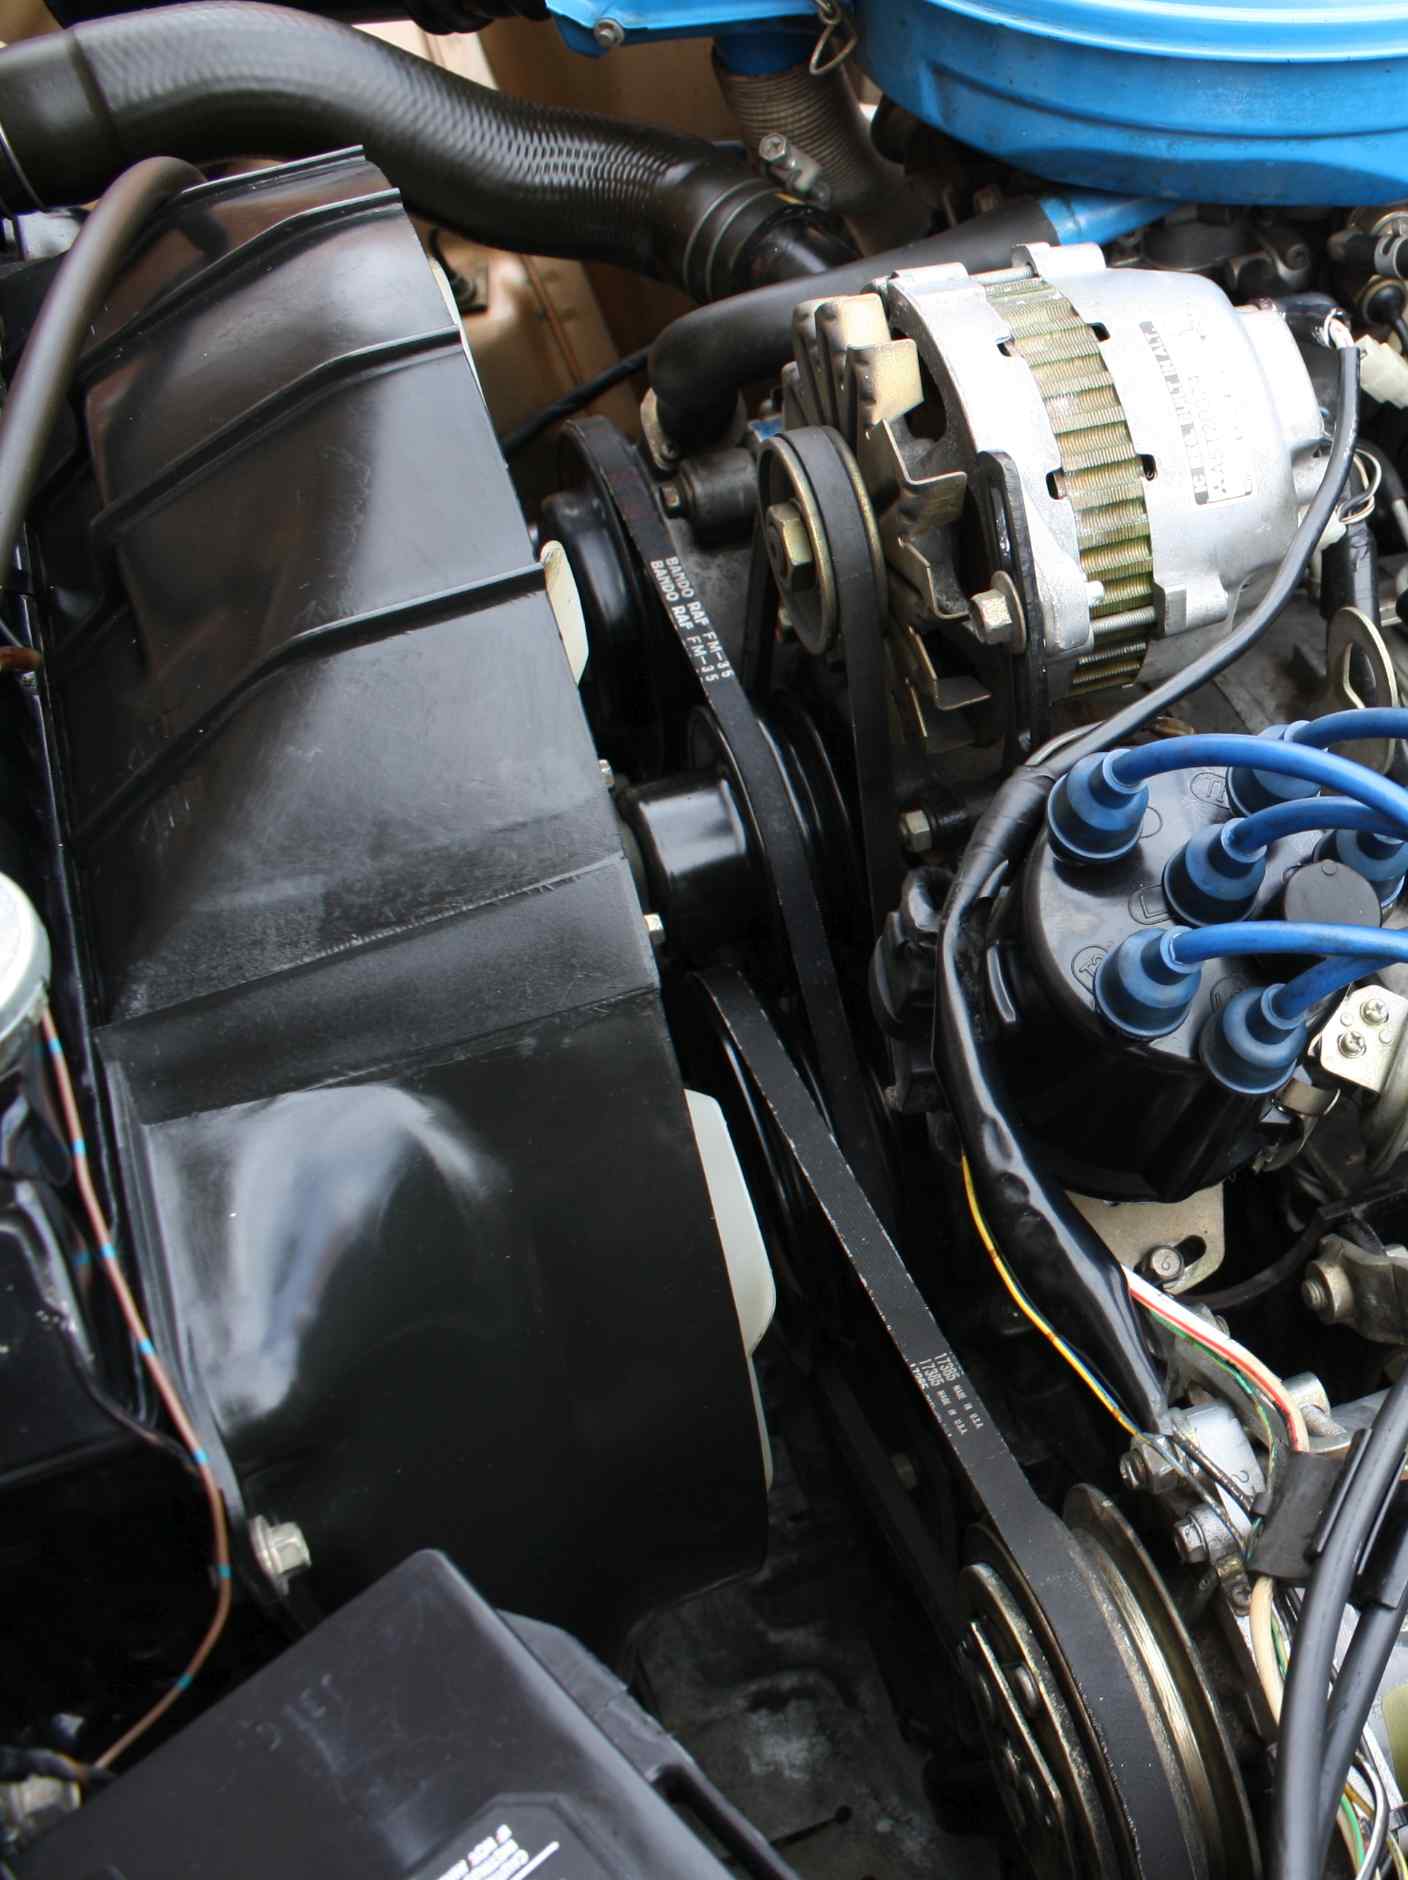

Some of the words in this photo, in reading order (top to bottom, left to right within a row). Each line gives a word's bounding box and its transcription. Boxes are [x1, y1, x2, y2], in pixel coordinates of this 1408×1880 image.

[649, 557, 681, 603] BANDO
[671, 603, 694, 633] RAF
[686, 634, 719, 684] FM-35
[665, 555, 696, 600] BANDO
[686, 600, 709, 629] RAF
[701, 630, 735, 680] FM-35
